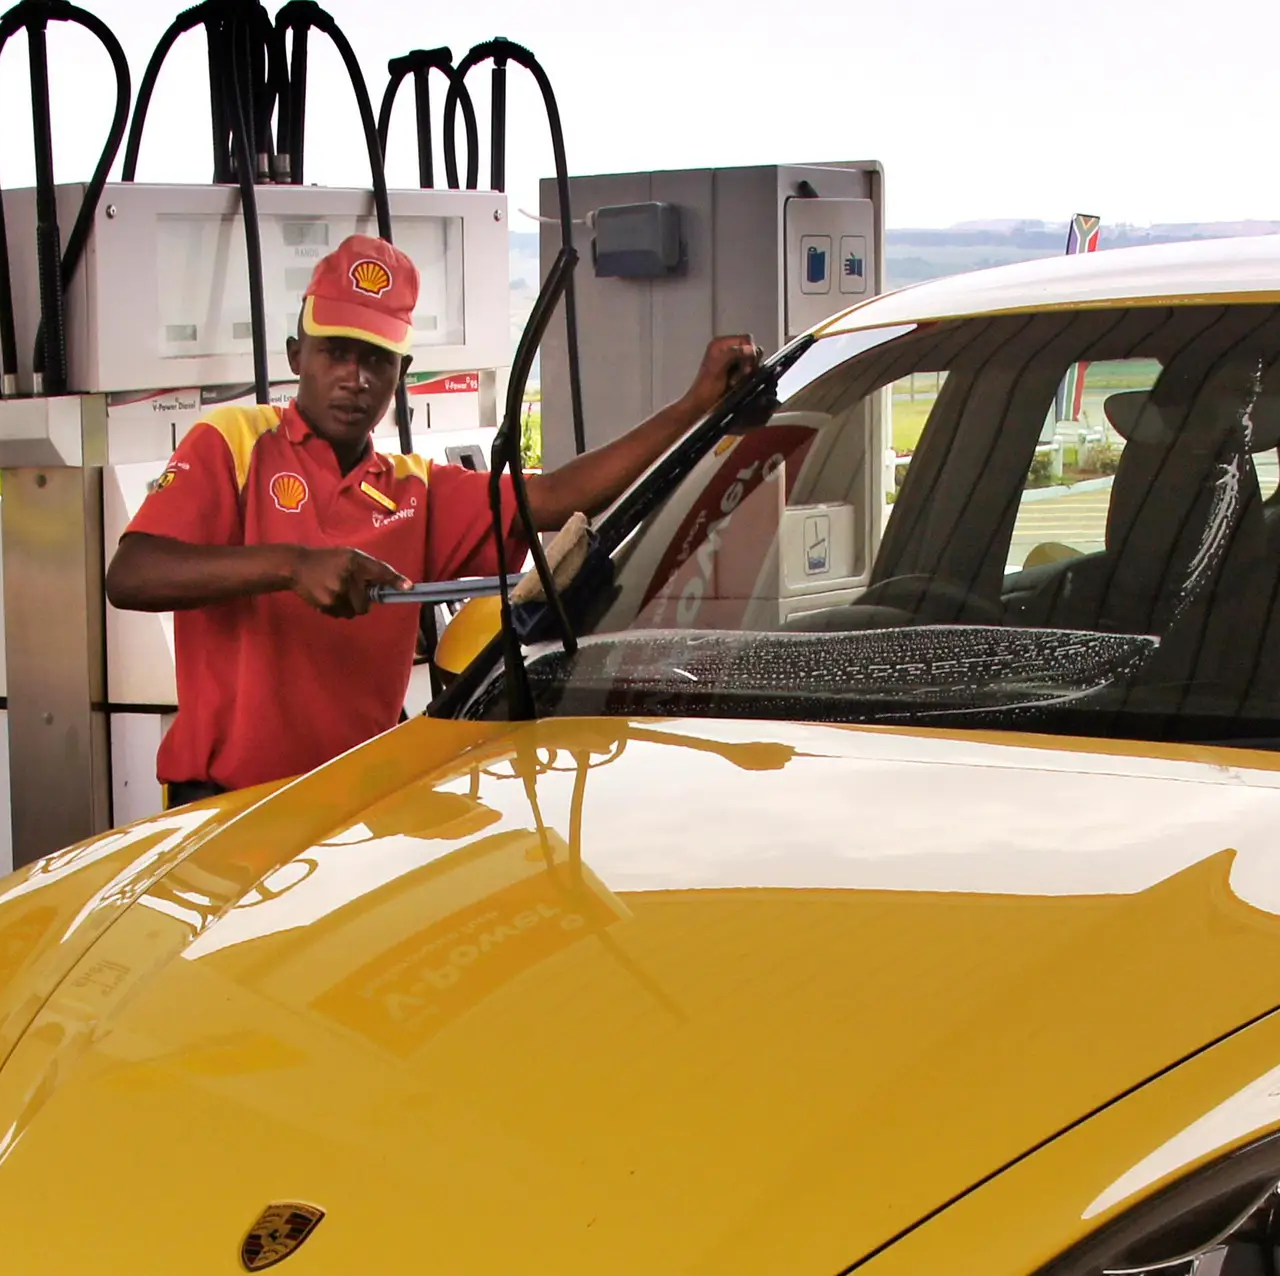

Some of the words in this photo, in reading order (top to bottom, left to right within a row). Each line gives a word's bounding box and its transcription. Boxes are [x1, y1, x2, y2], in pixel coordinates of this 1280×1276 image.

[294, 247, 320, 257] RANDS
[152, 403, 177, 411] V-Power
[178, 400, 196, 410] Diesel
